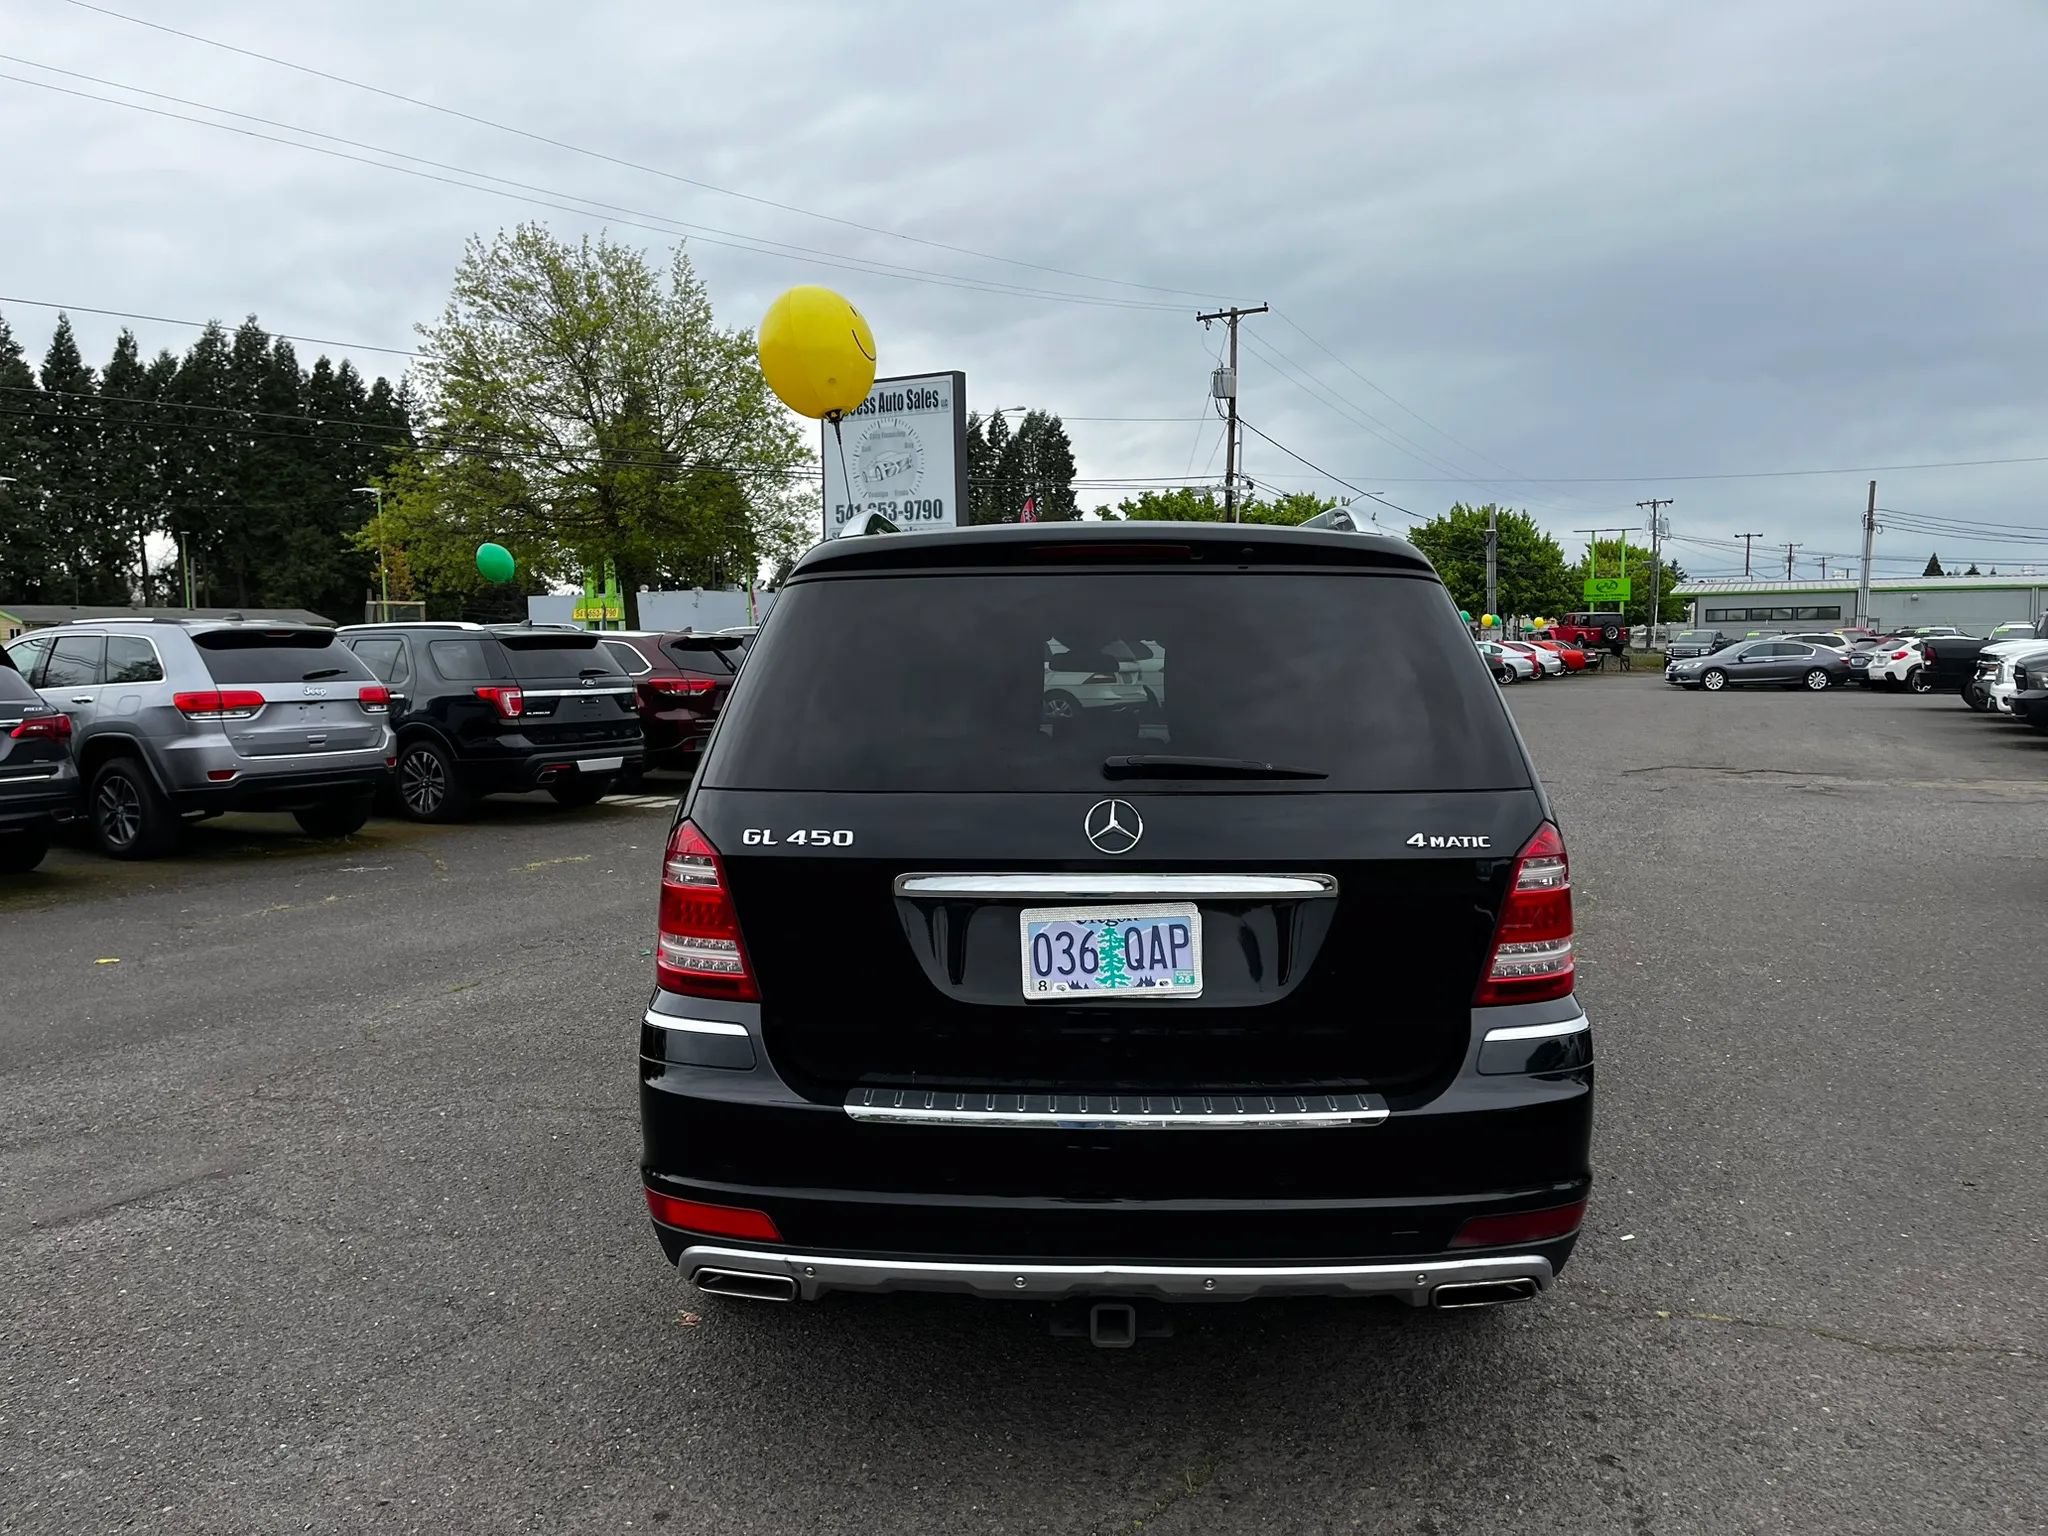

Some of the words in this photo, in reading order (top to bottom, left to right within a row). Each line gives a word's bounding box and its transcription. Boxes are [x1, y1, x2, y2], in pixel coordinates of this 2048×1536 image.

[879, 391, 904, 413] Auto
[906, 387, 939, 410] Sales
[835, 499, 943, 524] 54153-9790
[304, 687, 327, 696] Jeep
[742, 828, 779, 846] GL
[786, 829, 854, 847] 450
[1033, 930, 1100, 977] 036
[1124, 923, 1190, 971] QAP
[1038, 980, 1048, 991] 8
[1177, 975, 1192, 984] 26
